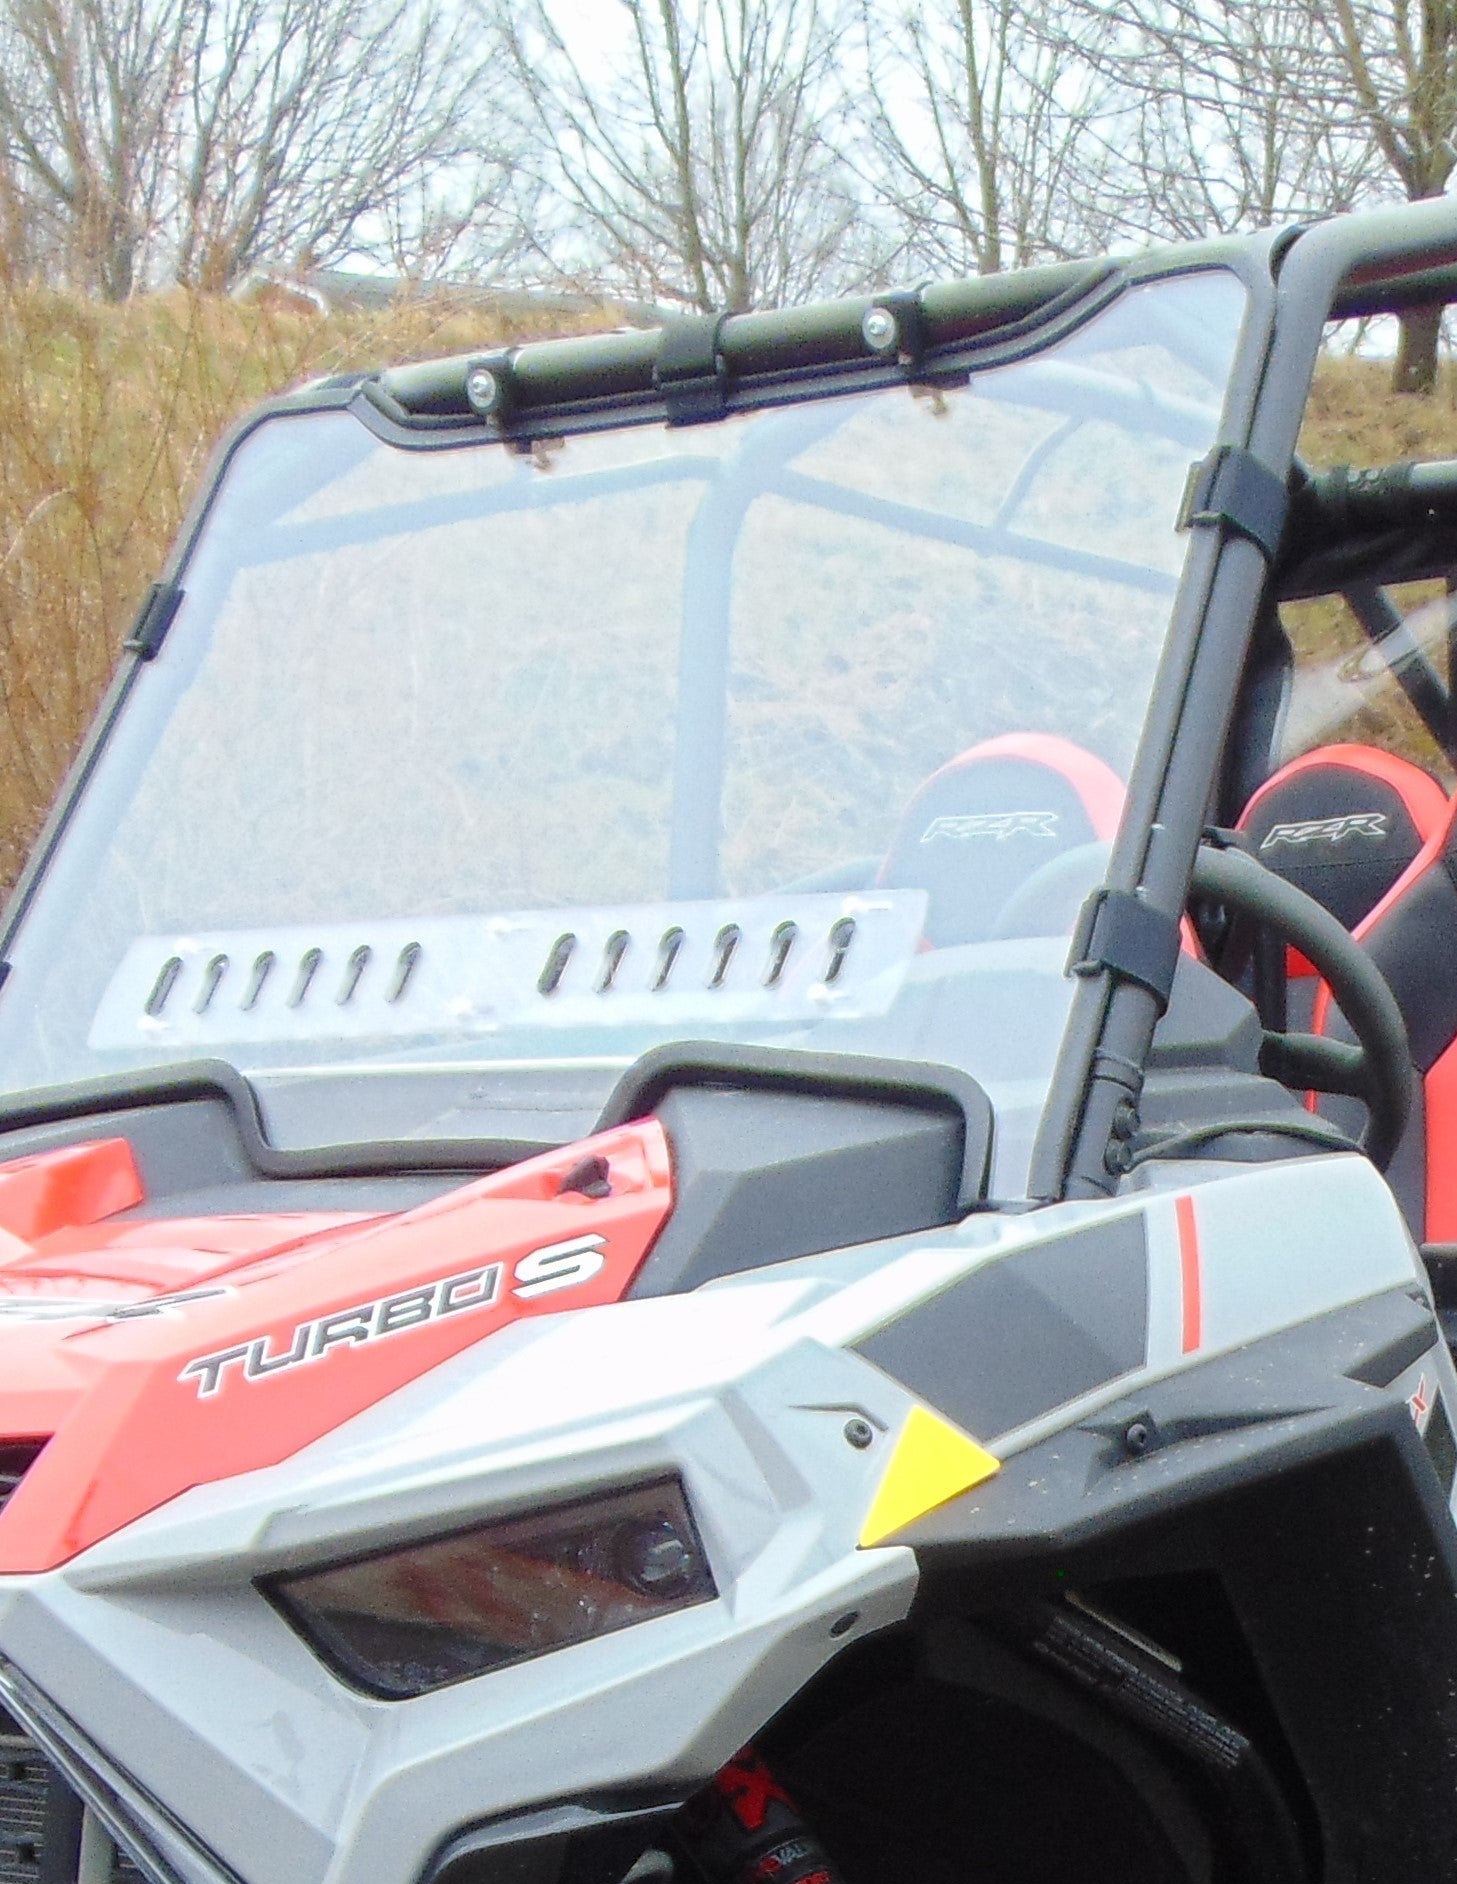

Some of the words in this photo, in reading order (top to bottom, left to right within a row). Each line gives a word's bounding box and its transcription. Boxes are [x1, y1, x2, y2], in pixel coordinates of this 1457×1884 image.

[920, 811, 1059, 844] RZR
[1260, 812, 1388, 850] RZR
[176, 1261, 506, 1400] TURBO
[510, 1232, 610, 1300] S
